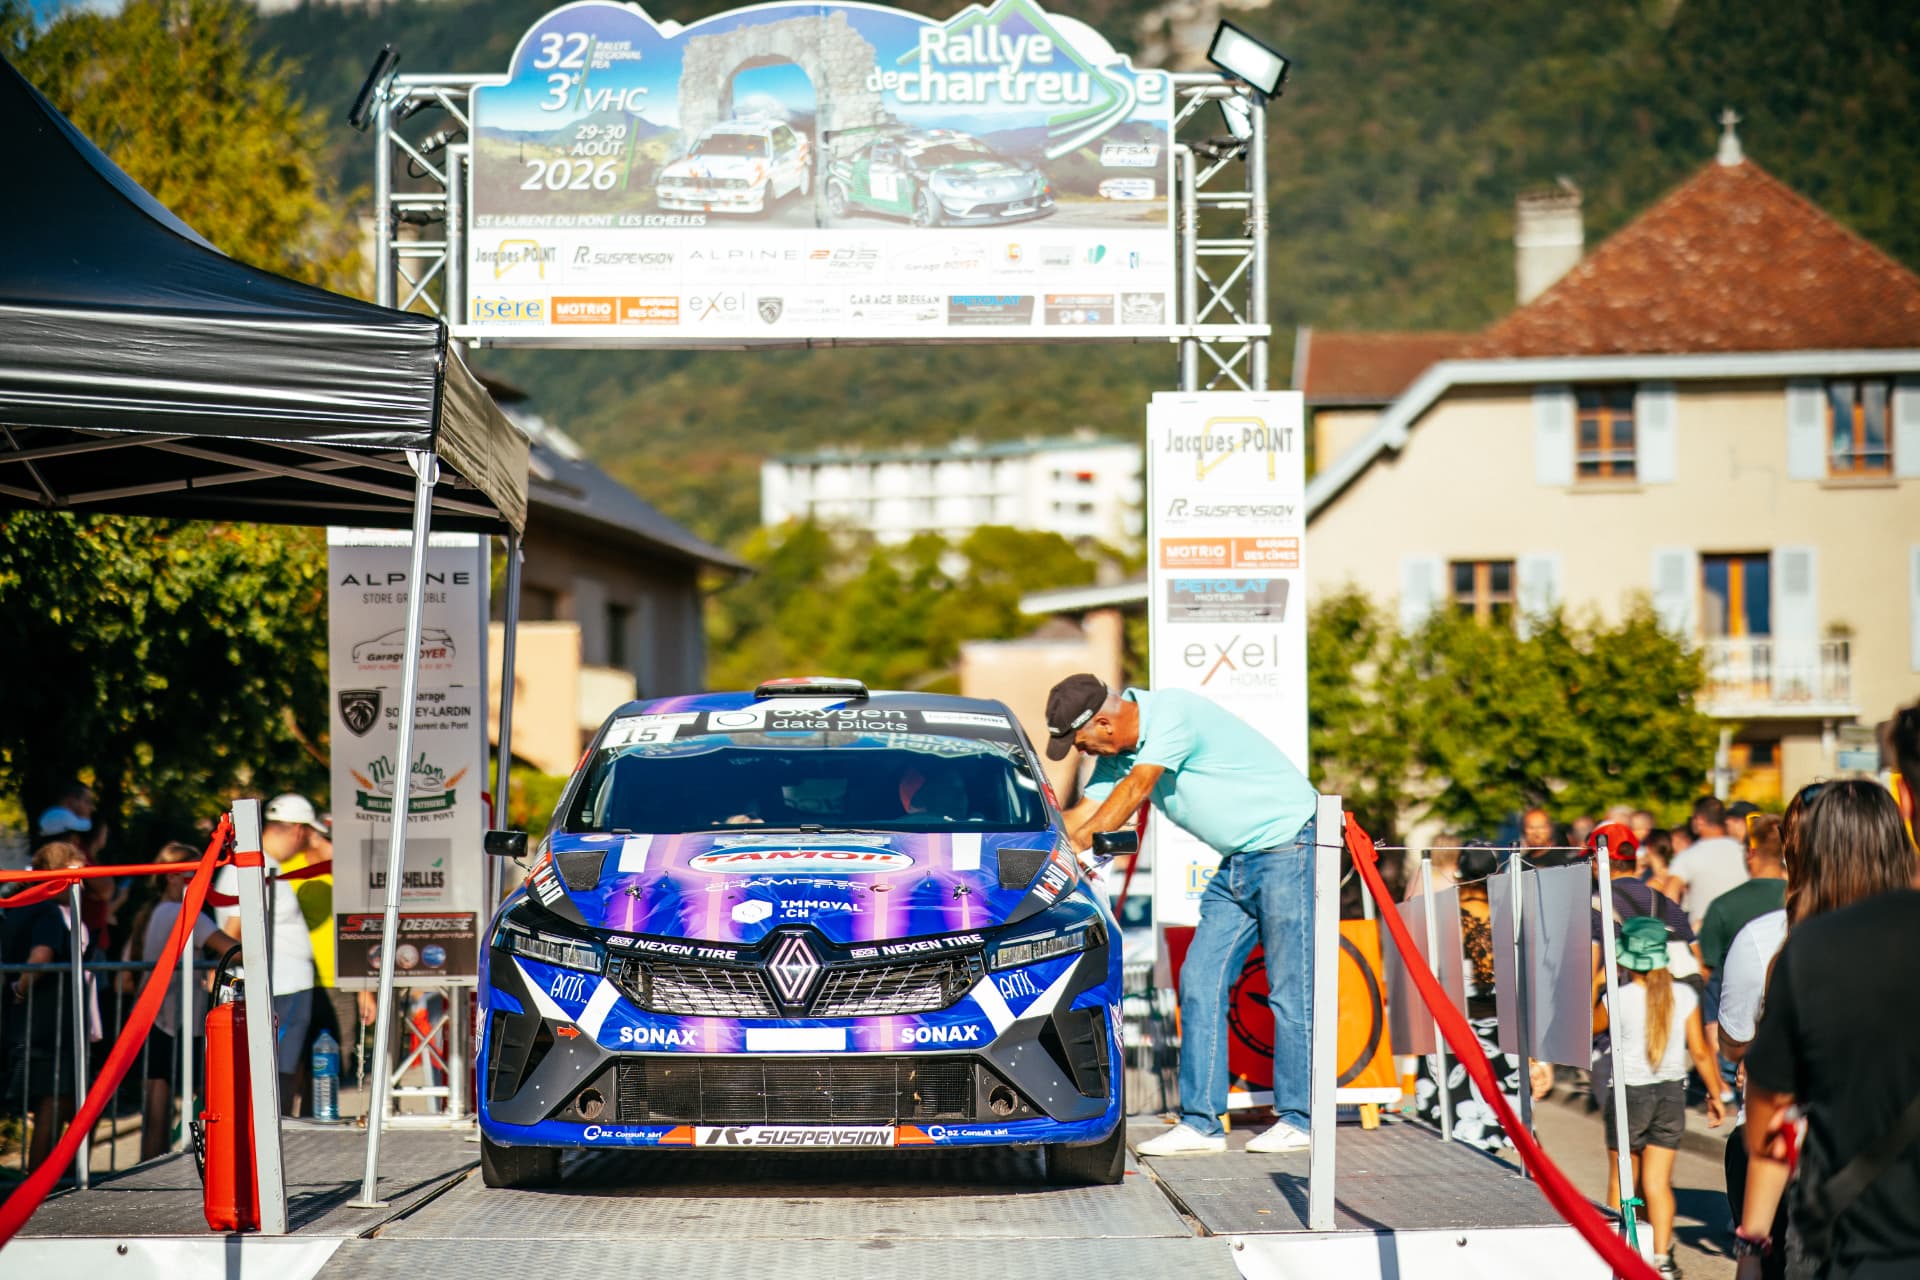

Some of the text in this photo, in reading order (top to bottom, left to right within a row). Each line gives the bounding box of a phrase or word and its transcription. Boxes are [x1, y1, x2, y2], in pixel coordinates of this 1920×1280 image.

[533, 32, 590, 69] 32
[922, 24, 1053, 73] Rallye
[866, 66, 898, 92] de
[583, 87, 648, 112] VHC
[575, 124, 626, 140] 29-30
[519, 159, 617, 191] 2026
[477, 214, 706, 228] ST LAURENT DU PONT LES ECHELLES
[522, 247, 556, 262] POINT
[690, 250, 798, 260] ALPINE
[689, 292, 745, 320] exel
[849, 294, 893, 305] GARAGE
[475, 296, 541, 318] isère
[556, 304, 611, 315] MOTRIO
[1166, 428, 1293, 459] Jacques POINT
[1165, 545, 1226, 558] MOTRIO
[341, 572, 470, 586] ALPNE
[1173, 579, 1270, 593] PETOLAT
[363, 592, 446, 604] STORE GROBLE
[1184, 634, 1278, 687] exel
[417, 693, 446, 703] arage
[773, 709, 907, 720] oxygen
[414, 722, 438, 730] aurent
[772, 719, 908, 731] data pilots
[621, 727, 662, 744] 15
[698, 851, 900, 865] TAMOIL
[780, 900, 863, 913] IMMOVAL
[780, 909, 809, 918] .CH
[402, 917, 473, 931] DEBOSSE
[635, 939, 694, 955] NEXEN
[696, 947, 738, 960] TIRE
[882, 938, 942, 956] NEXEN
[943, 933, 985, 948] TIRE
[620, 1027, 697, 1046] SONAX
[901, 1025, 978, 1044] SONAX
[947, 1129, 959, 1137] BZ
[961, 1129, 992, 1137] Consult
